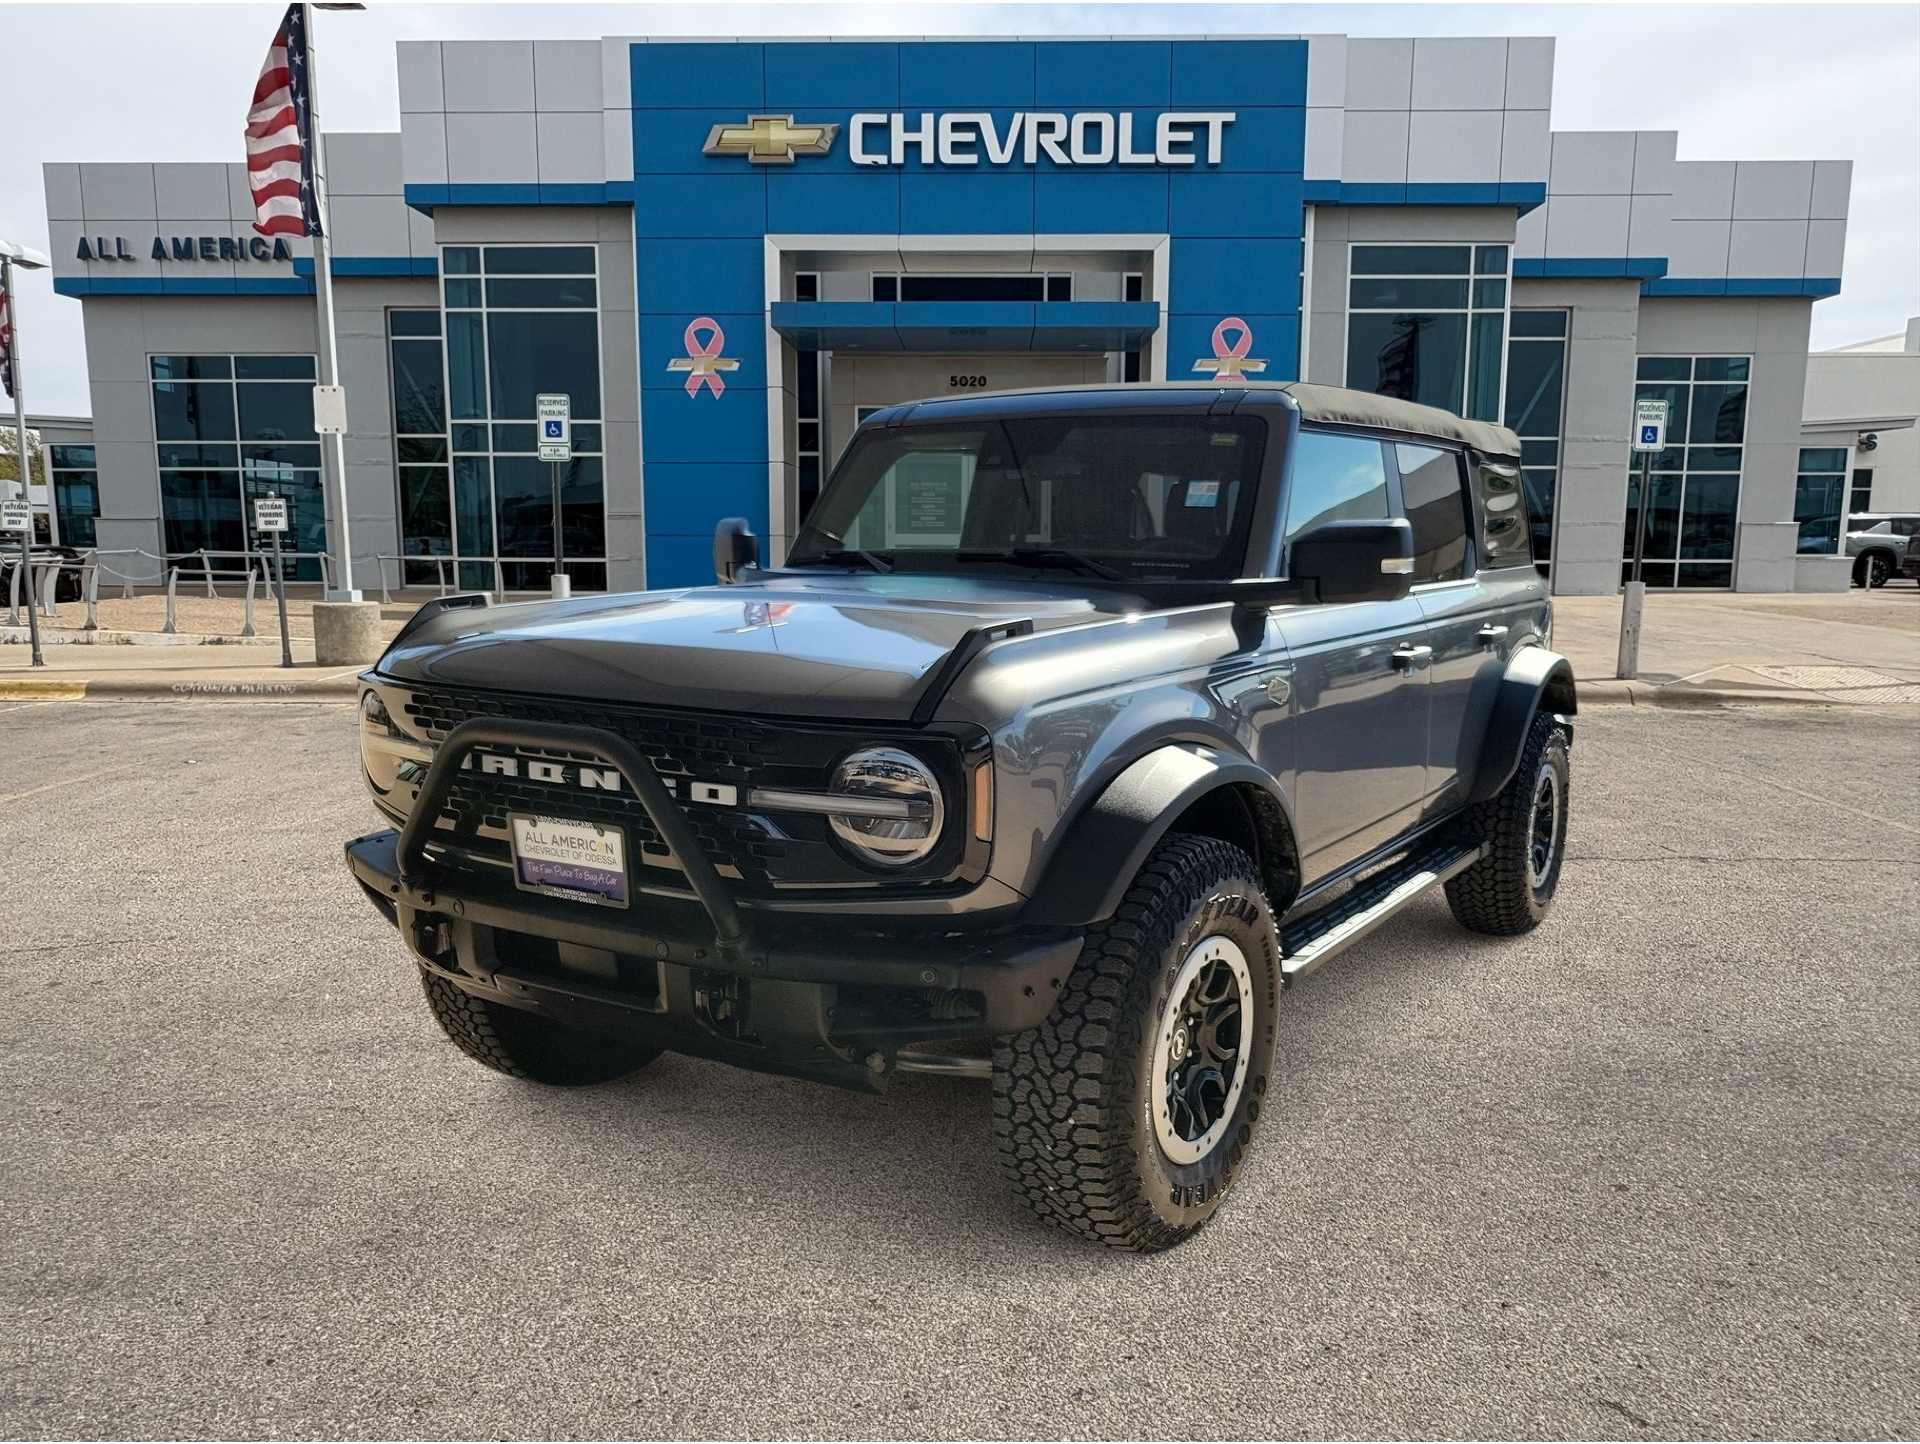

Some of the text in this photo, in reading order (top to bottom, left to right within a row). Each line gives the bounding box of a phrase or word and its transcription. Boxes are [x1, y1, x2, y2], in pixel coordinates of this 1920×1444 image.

[849, 111, 1237, 166] CHEVROLET
[76, 236, 292, 262] ALL AMERICA
[950, 375, 987, 387] 5020
[540, 409, 568, 417] PARKING
[525, 831, 548, 845] ALL
[524, 844, 618, 866] CHEVROLET OF ODESSA
